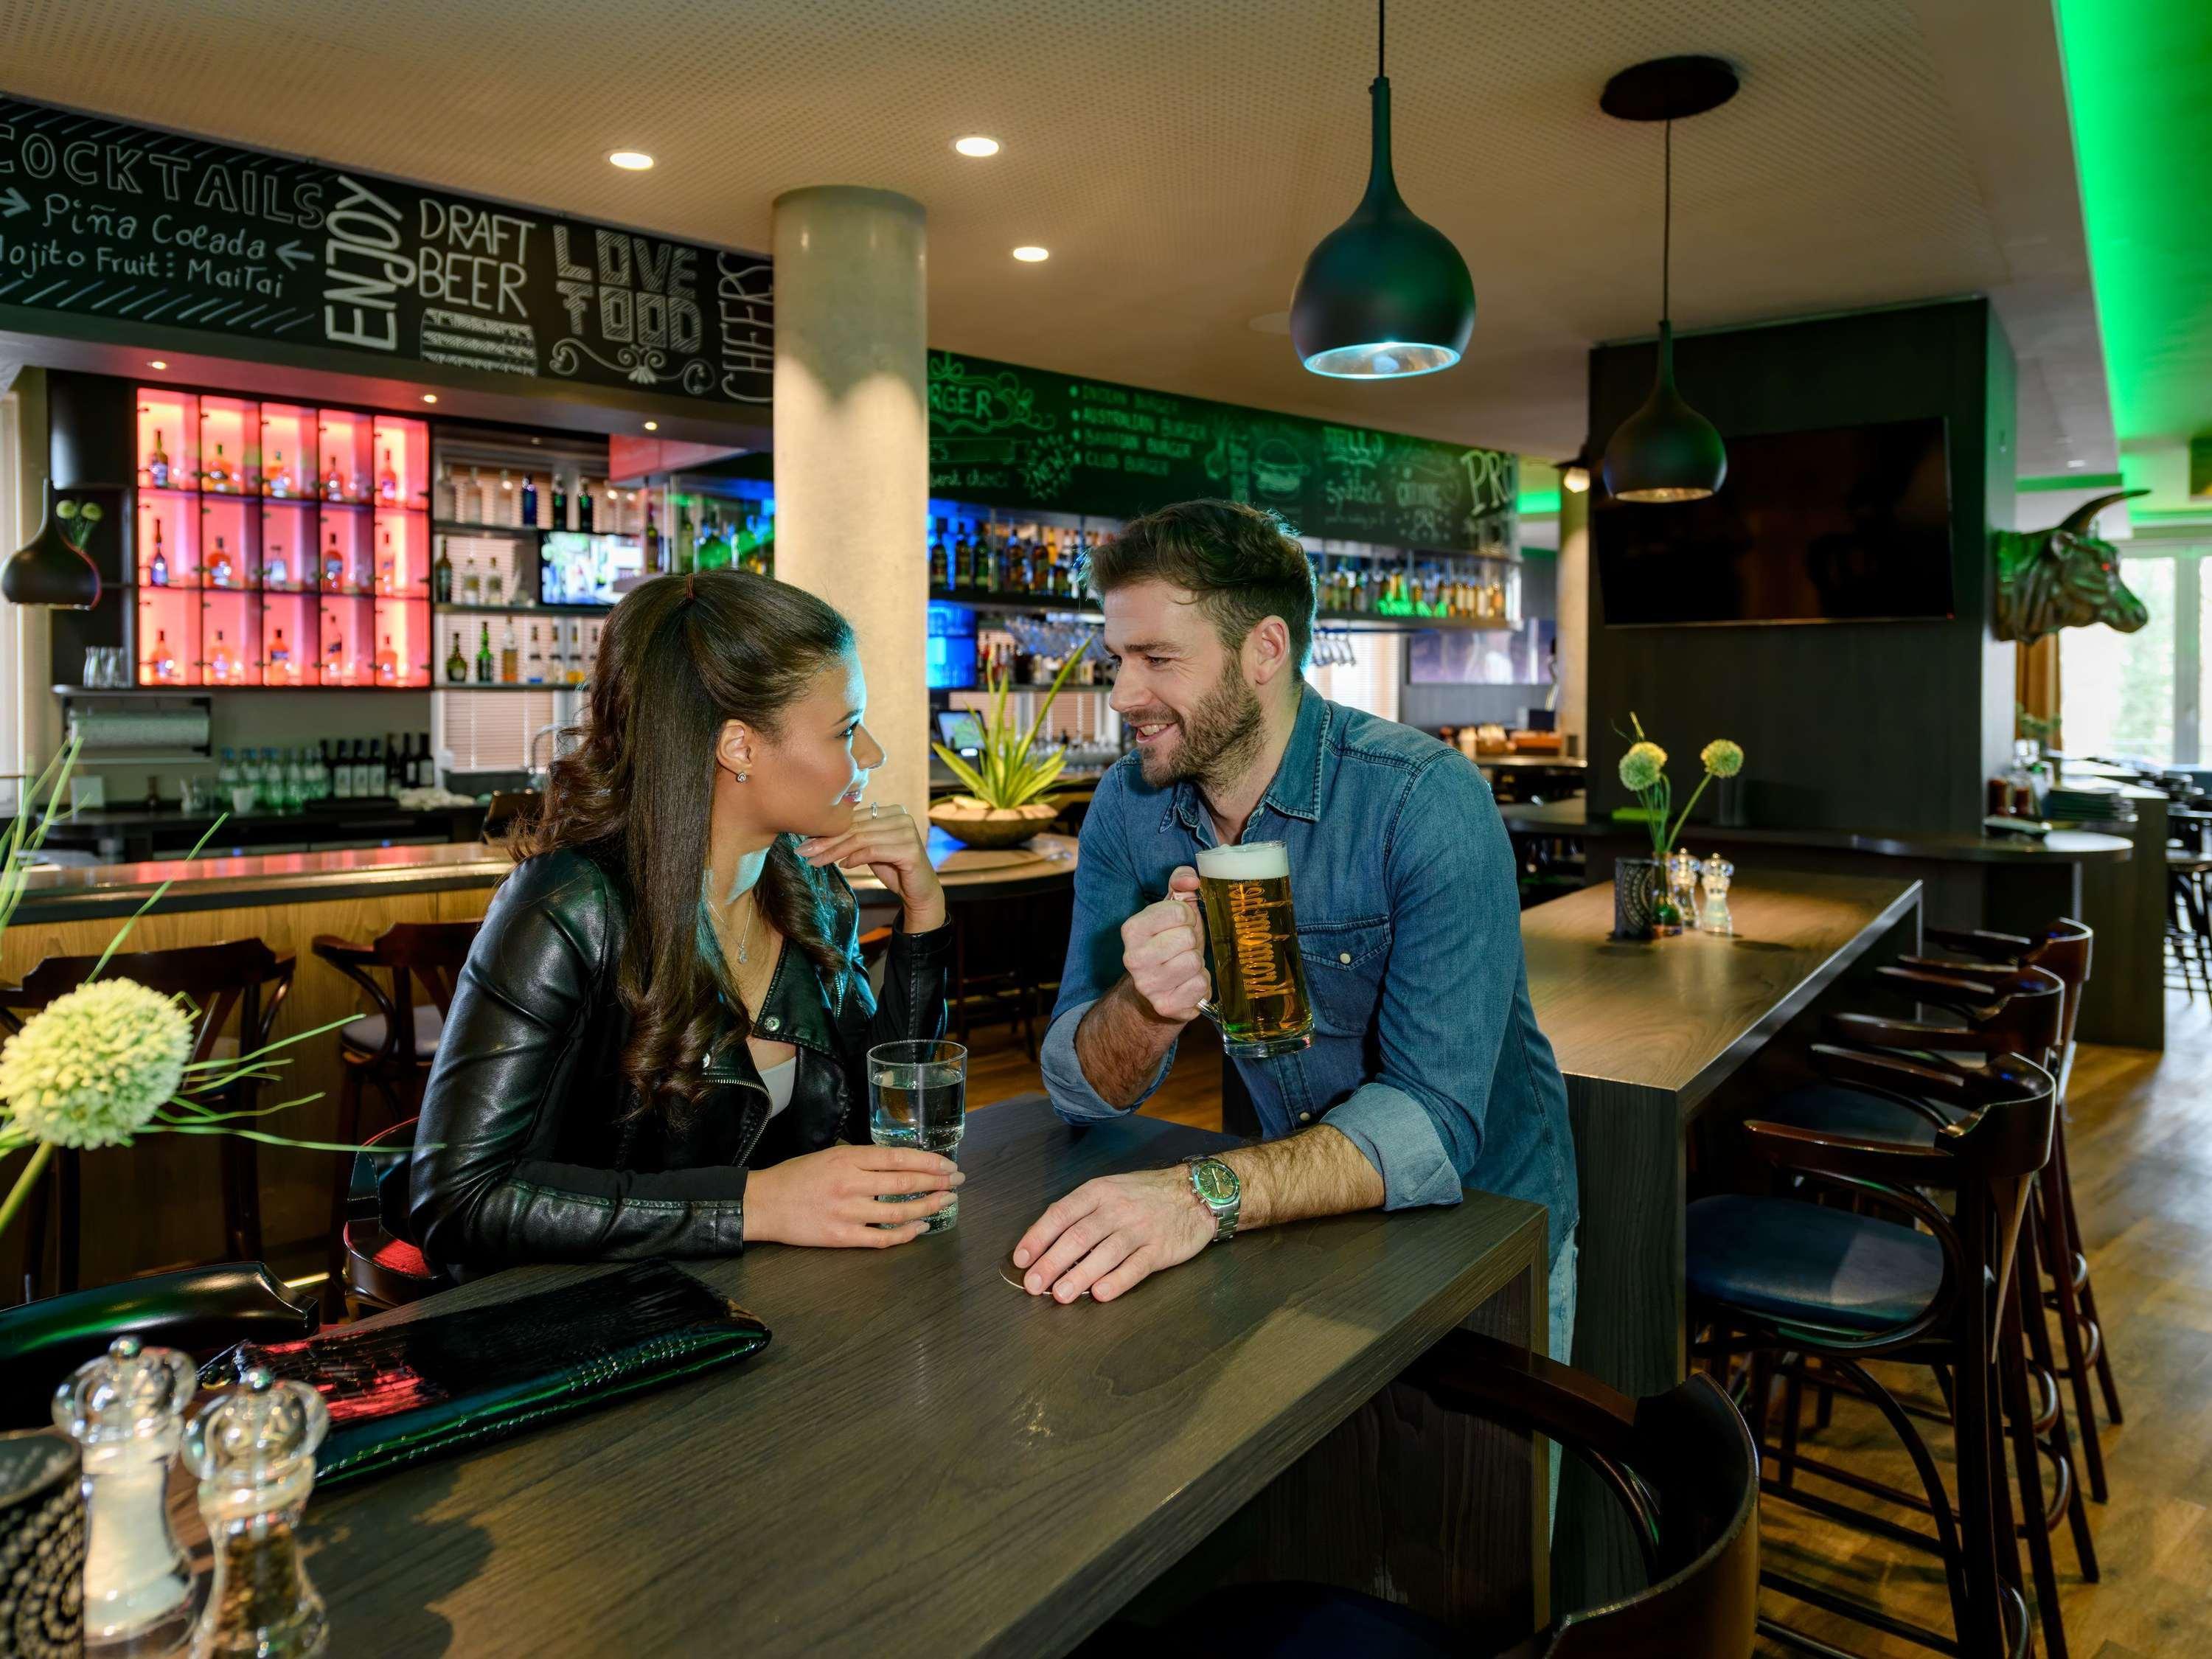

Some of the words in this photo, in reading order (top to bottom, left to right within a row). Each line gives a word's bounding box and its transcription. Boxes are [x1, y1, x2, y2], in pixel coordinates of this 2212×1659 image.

[42, 193, 138, 240] Piña
[153, 214, 266, 260] Colada
[420, 198, 536, 264] DRAFT
[0, 234, 85, 279] ojito
[97, 247, 159, 277] Fruit
[323, 175, 417, 351] ENJOY
[419, 247, 529, 318] BEER
[553, 224, 698, 299] LOVE
[929, 383, 993, 419] RGER
[1145, 436, 1192, 459] BURGER
[1160, 417, 1207, 441] BURGER
[1123, 455, 1170, 478] BURGER
